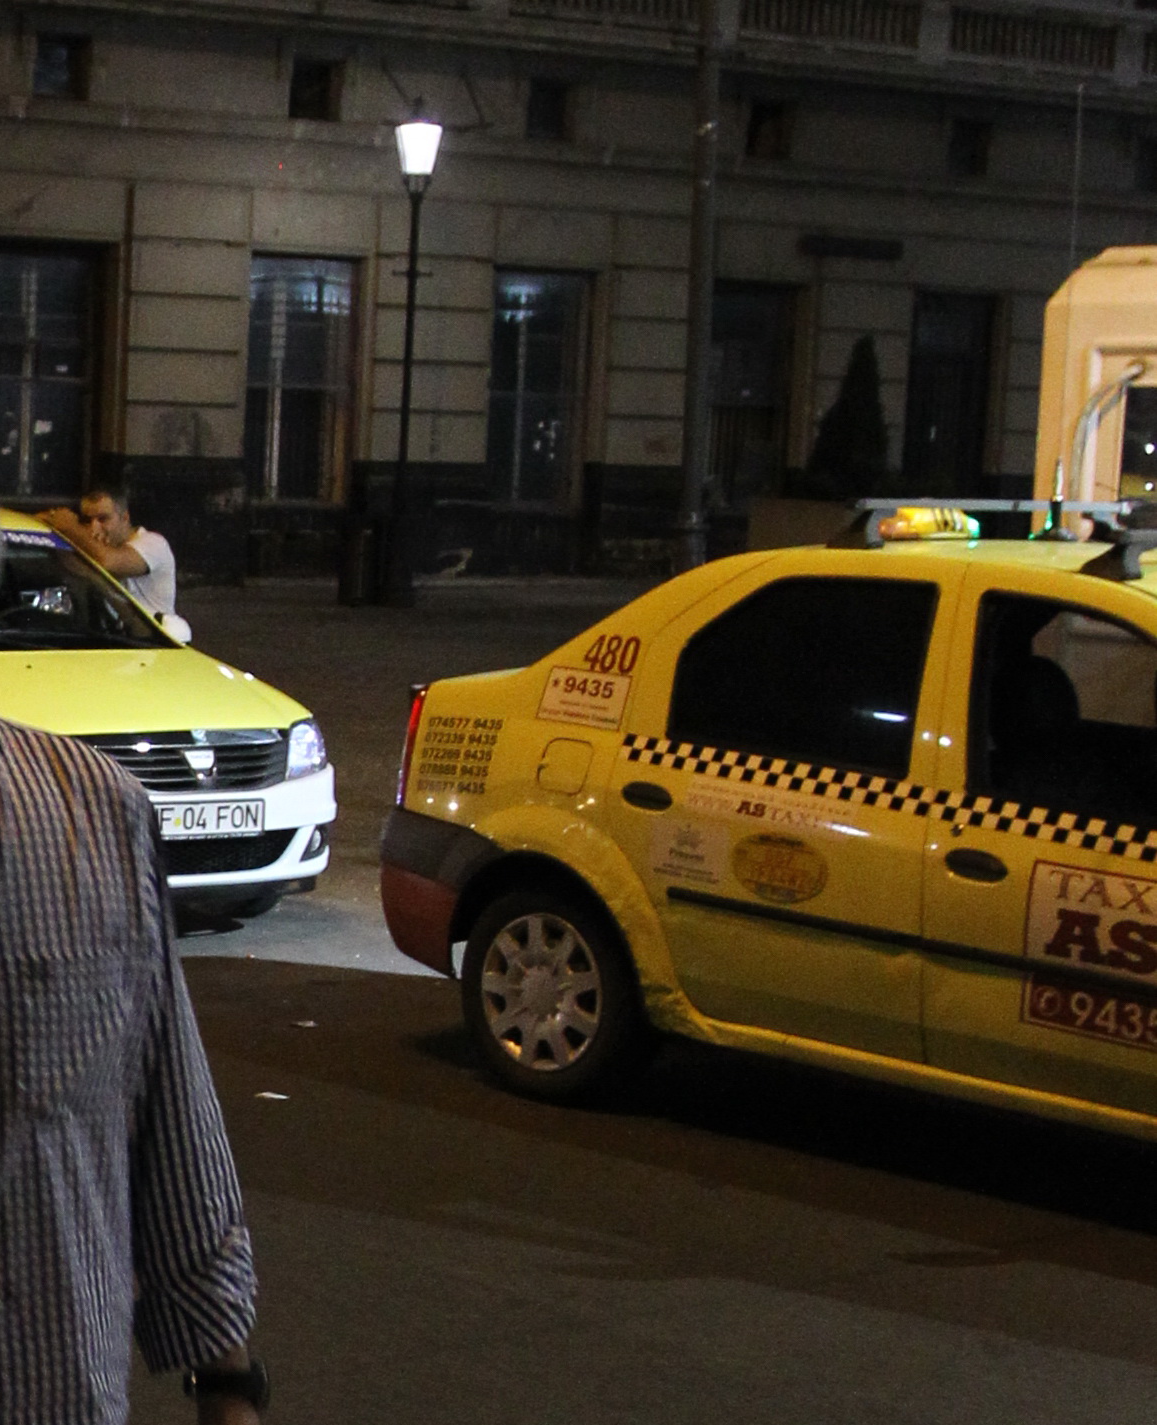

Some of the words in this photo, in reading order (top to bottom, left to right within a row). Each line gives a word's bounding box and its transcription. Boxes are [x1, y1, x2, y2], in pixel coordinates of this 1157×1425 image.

[584, 635, 641, 674] 480
[564, 676, 615, 699] 9435
[182, 806, 207, 830] 04
[215, 803, 259, 830] FON
[1045, 908, 1157, 975] AS
